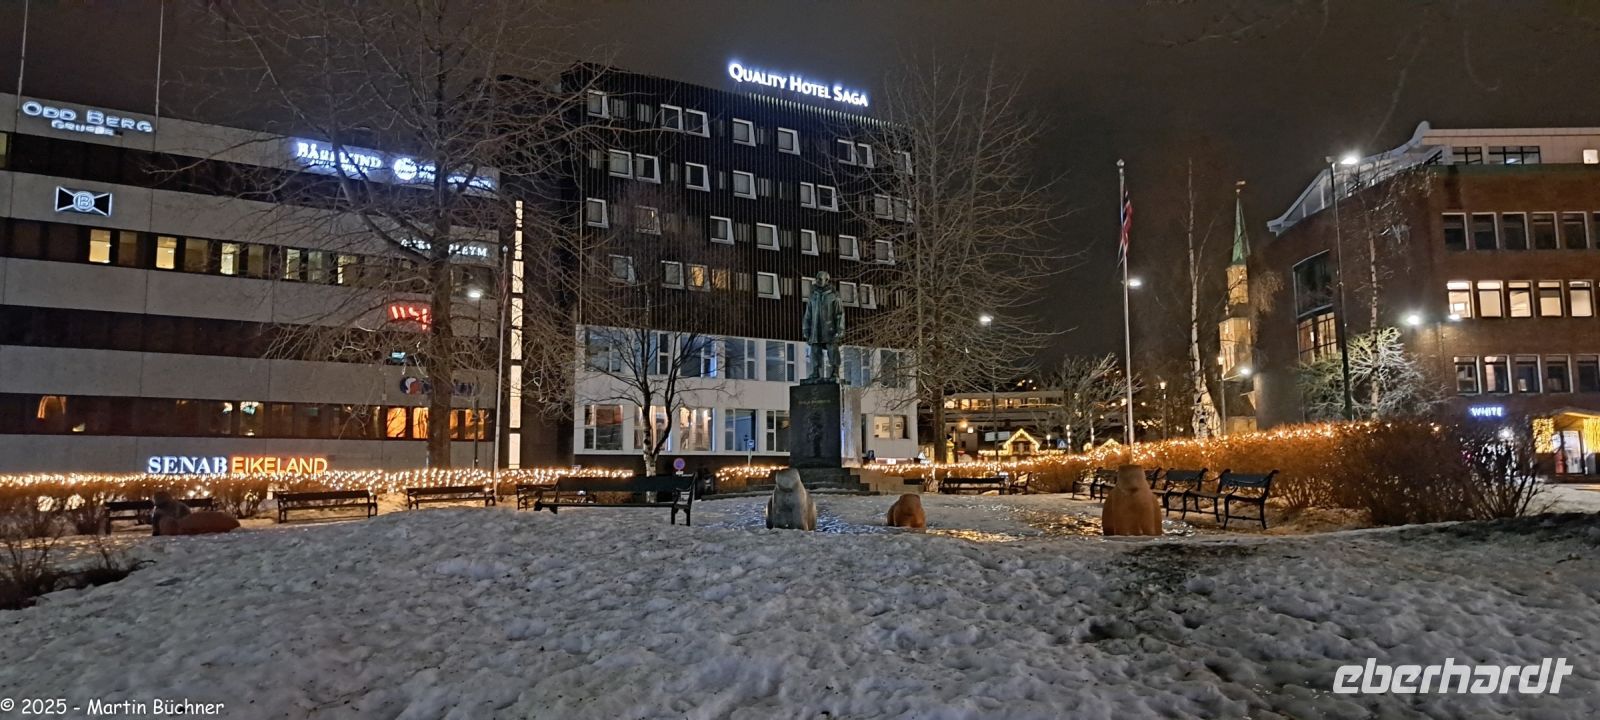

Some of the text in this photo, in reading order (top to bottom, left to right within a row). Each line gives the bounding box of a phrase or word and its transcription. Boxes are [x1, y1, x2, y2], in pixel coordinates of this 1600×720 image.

[728, 63, 869, 107] QUALITY HOTEL SAGA
[22, 101, 153, 133] ODD BERG
[147, 456, 328, 474] SENAB EIKELAND
